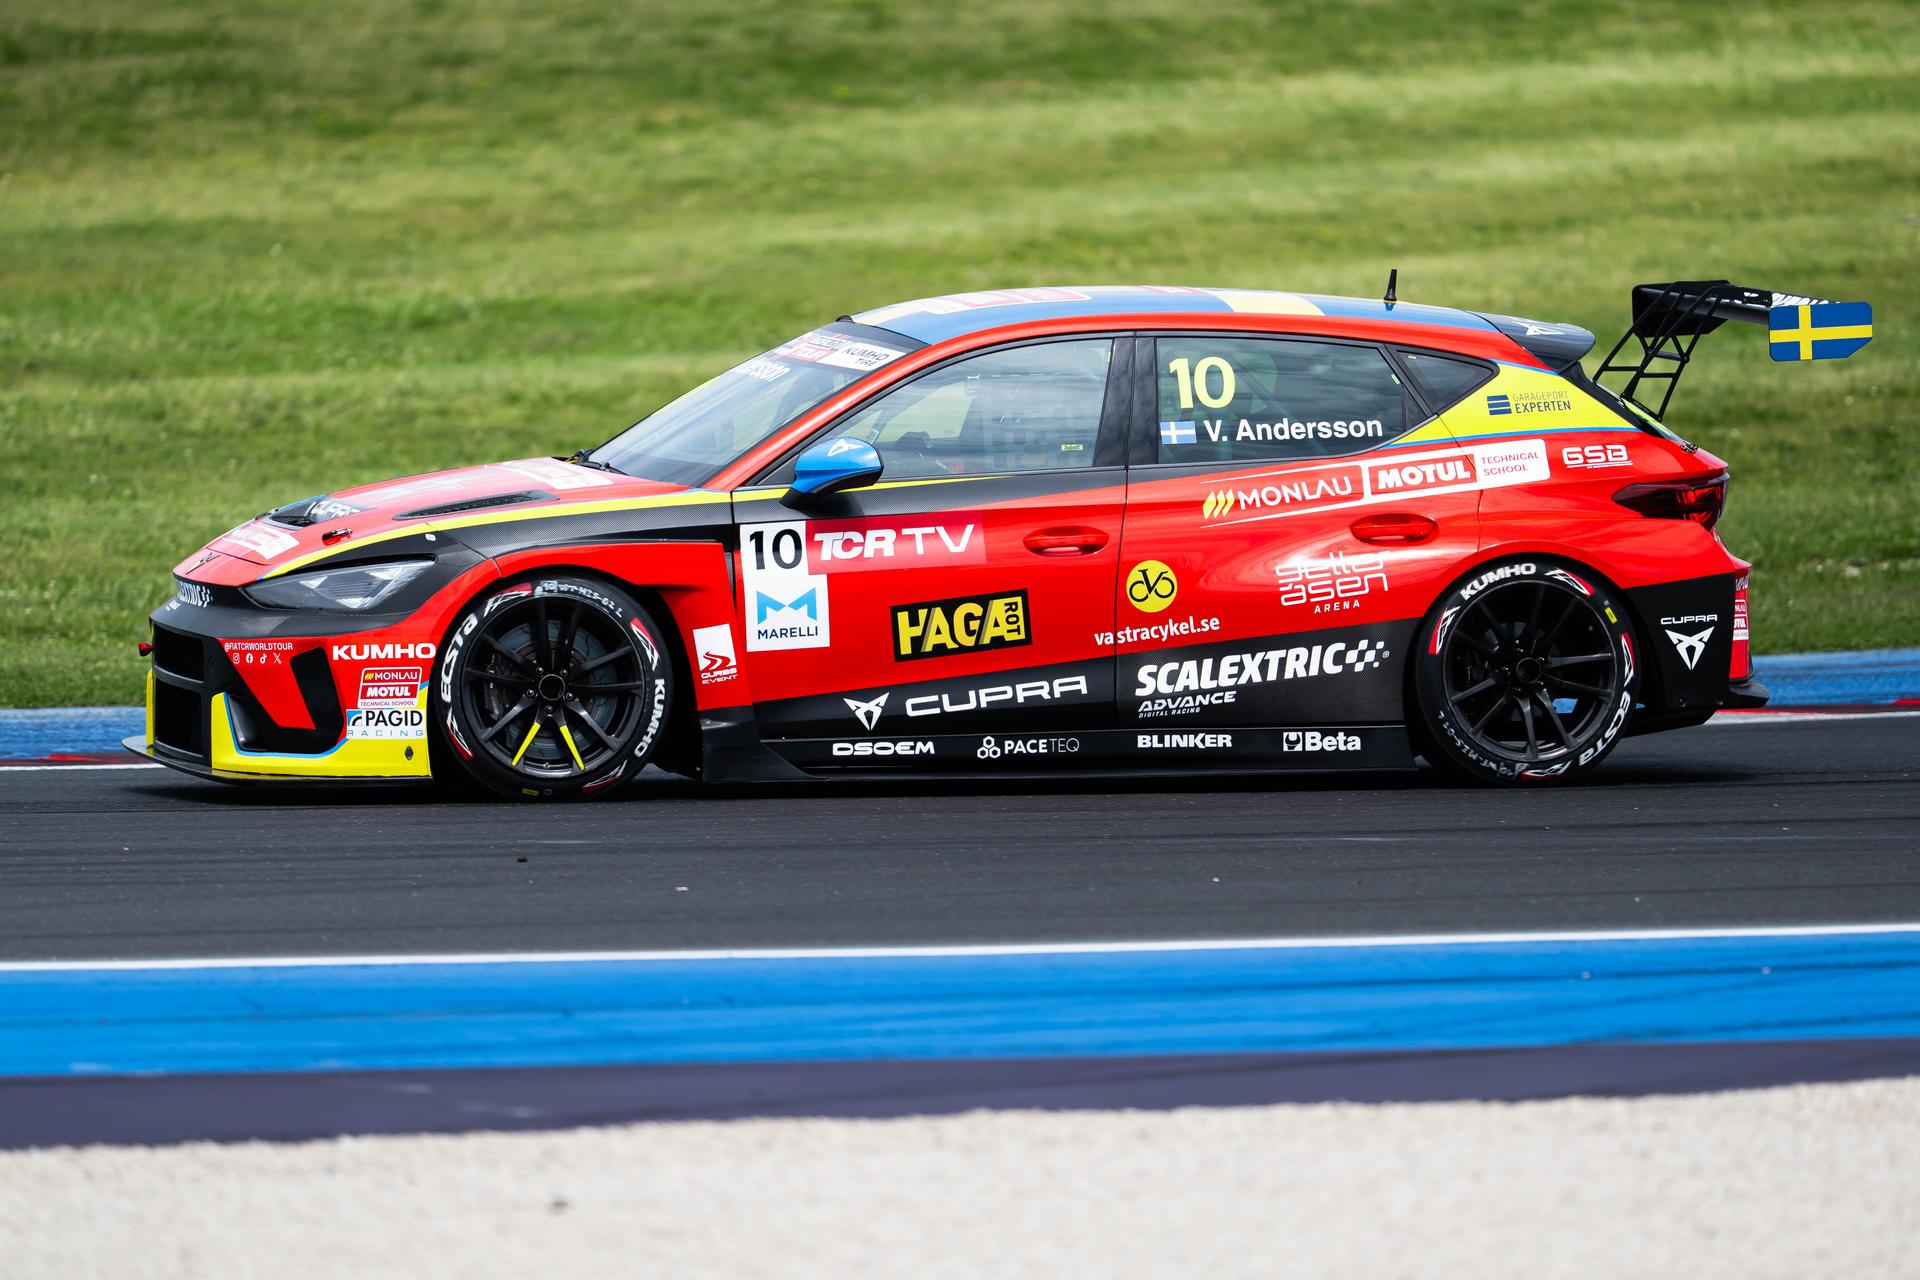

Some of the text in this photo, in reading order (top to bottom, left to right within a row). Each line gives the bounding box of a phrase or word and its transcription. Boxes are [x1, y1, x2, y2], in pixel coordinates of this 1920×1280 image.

[843, 346, 890, 361] KUMHO
[1168, 356, 1236, 409] 10
[1512, 390, 1569, 403] GARAGEPORT
[1514, 400, 1572, 414] EXPERTEN
[1203, 417, 1384, 442] V. Andersson
[1480, 451, 1541, 466] TECHNICAL
[1377, 460, 1472, 491] MOTUL
[1483, 464, 1529, 477] SCHOOL
[1237, 475, 1352, 511] MONLAU
[749, 528, 803, 570] 10
[813, 524, 976, 562] TCR TV
[1459, 562, 1537, 600] KUMHO
[1314, 599, 1360, 614] ARENA
[896, 597, 1004, 656] HAGA
[1003, 600, 1023, 636] ROT
[1661, 614, 1718, 625] CUPRA
[757, 625, 819, 641] MARELLI
[1094, 615, 1220, 646] vastracykel.se
[224, 642, 293, 652] @FIATCRWORLDTOUR
[332, 643, 436, 661] KUMHO
[374, 671, 418, 681] MONLAU
[1135, 642, 1346, 697] SCALEXTRIC
[702, 674, 739, 684] EVENT
[366, 685, 411, 698] MOTUL
[905, 675, 1088, 717] CUPRA
[1138, 690, 1237, 713] ADVANCE
[365, 709, 423, 727] PAGID
[634, 678, 666, 758] KUMHO
[1138, 704, 1201, 719] DIGITAL RACING
[346, 730, 424, 738] RACING
[1137, 732, 1233, 749] BLINKER
[1305, 731, 1361, 752] Beta
[832, 741, 935, 756] DSOEM
